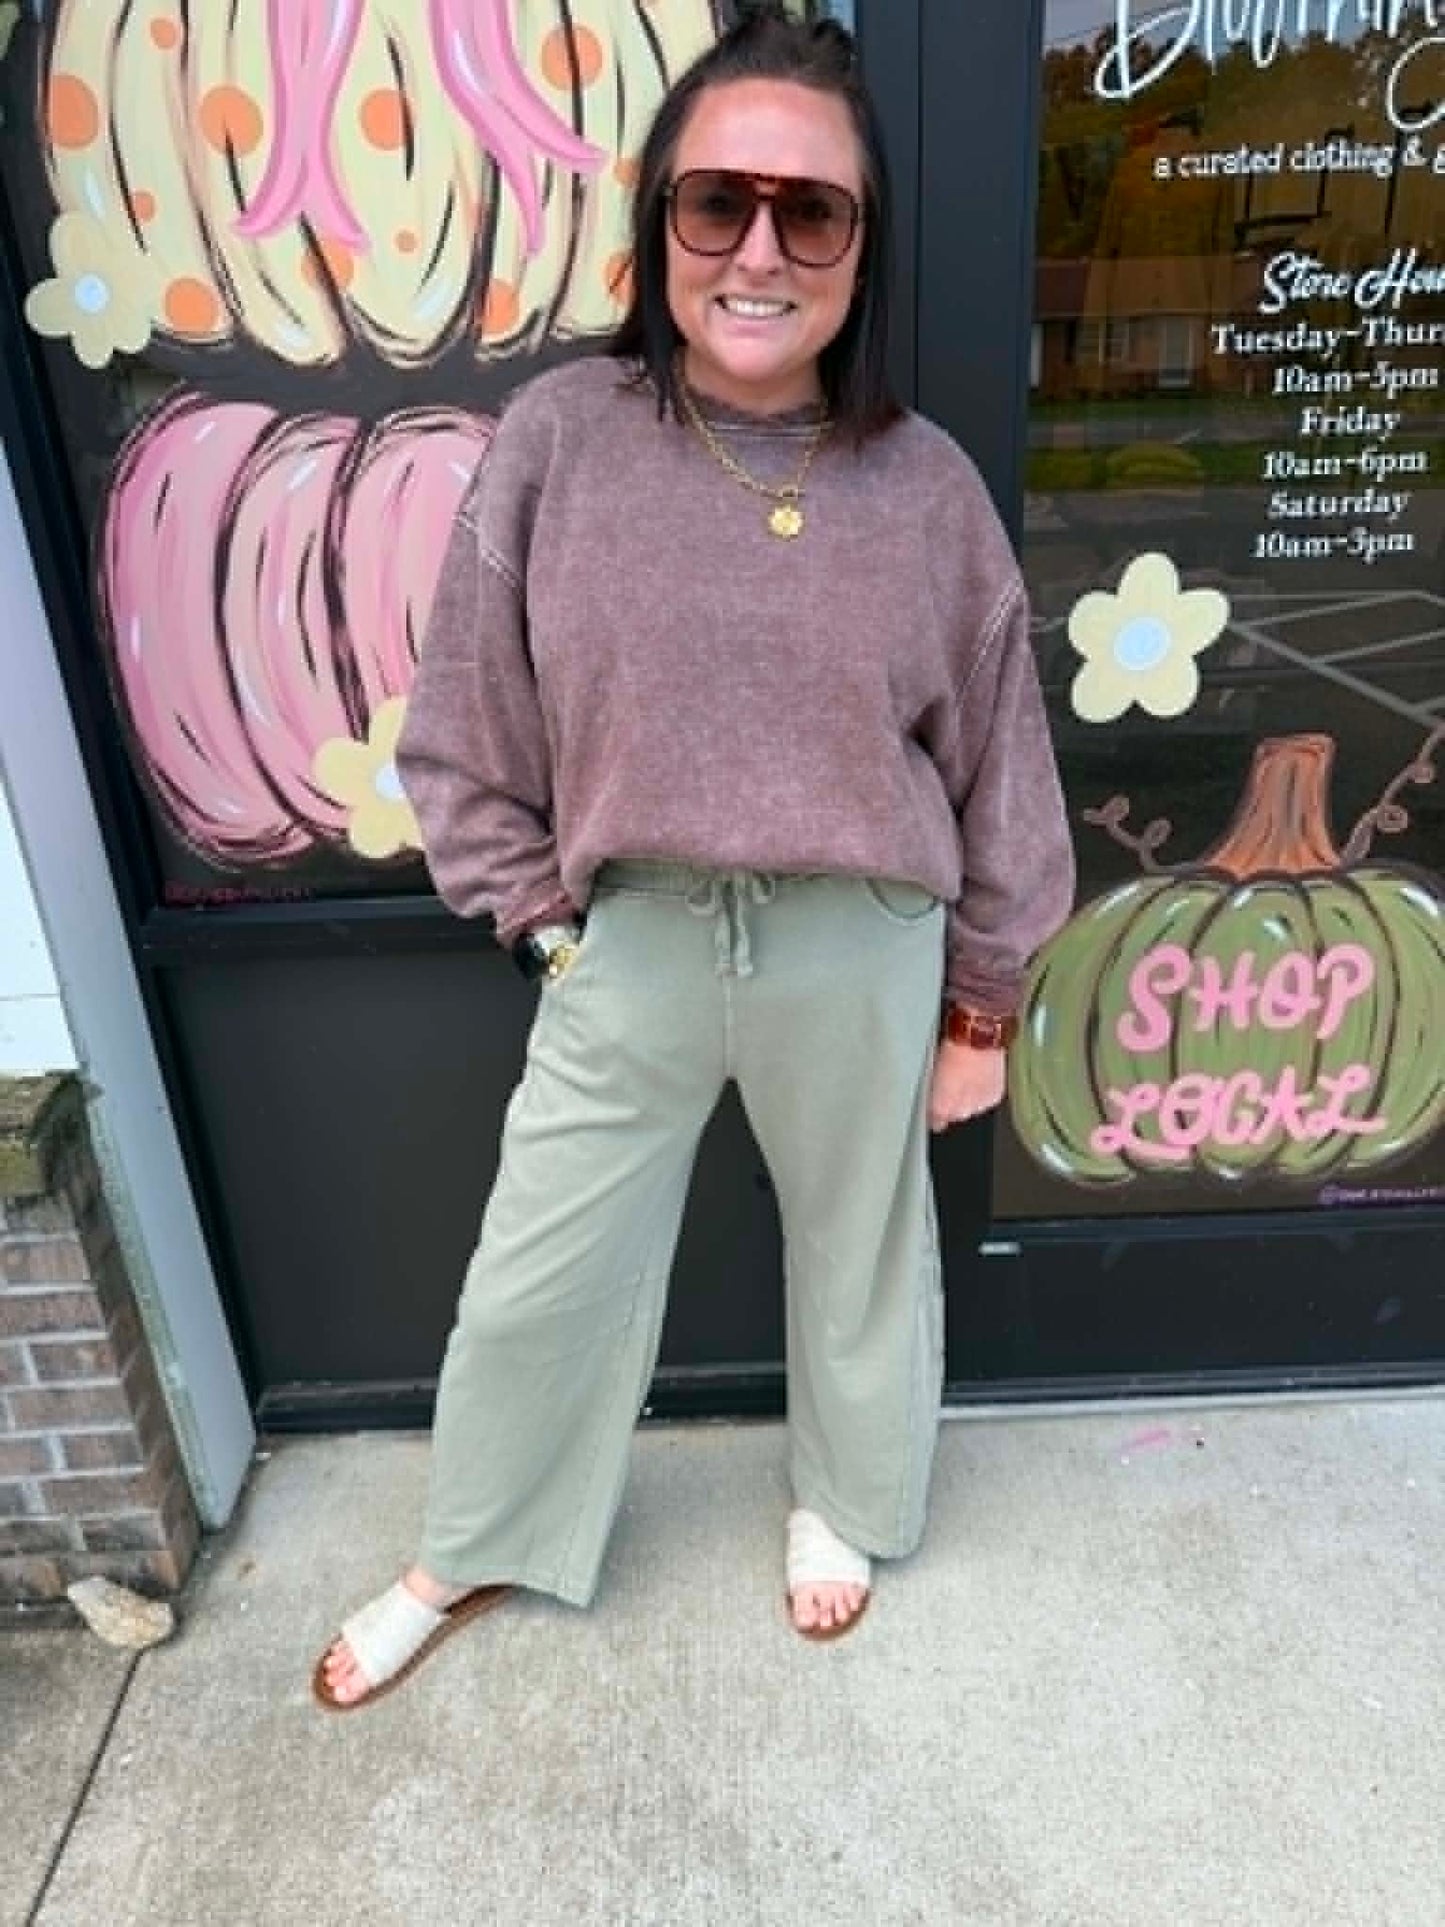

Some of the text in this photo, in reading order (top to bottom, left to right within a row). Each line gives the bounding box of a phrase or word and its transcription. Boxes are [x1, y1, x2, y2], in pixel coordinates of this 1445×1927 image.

[1152, 156, 1174, 179] a
[1178, 143, 1282, 179] curated
[1288, 138, 1394, 179] clothing
[1402, 135, 1428, 167] &
[1301, 406, 1402, 443] Friday
[1267, 488, 1415, 524] Saturday
[1116, 943, 1376, 1052] SHOP
[1089, 1064, 1389, 1160] LOCAL
